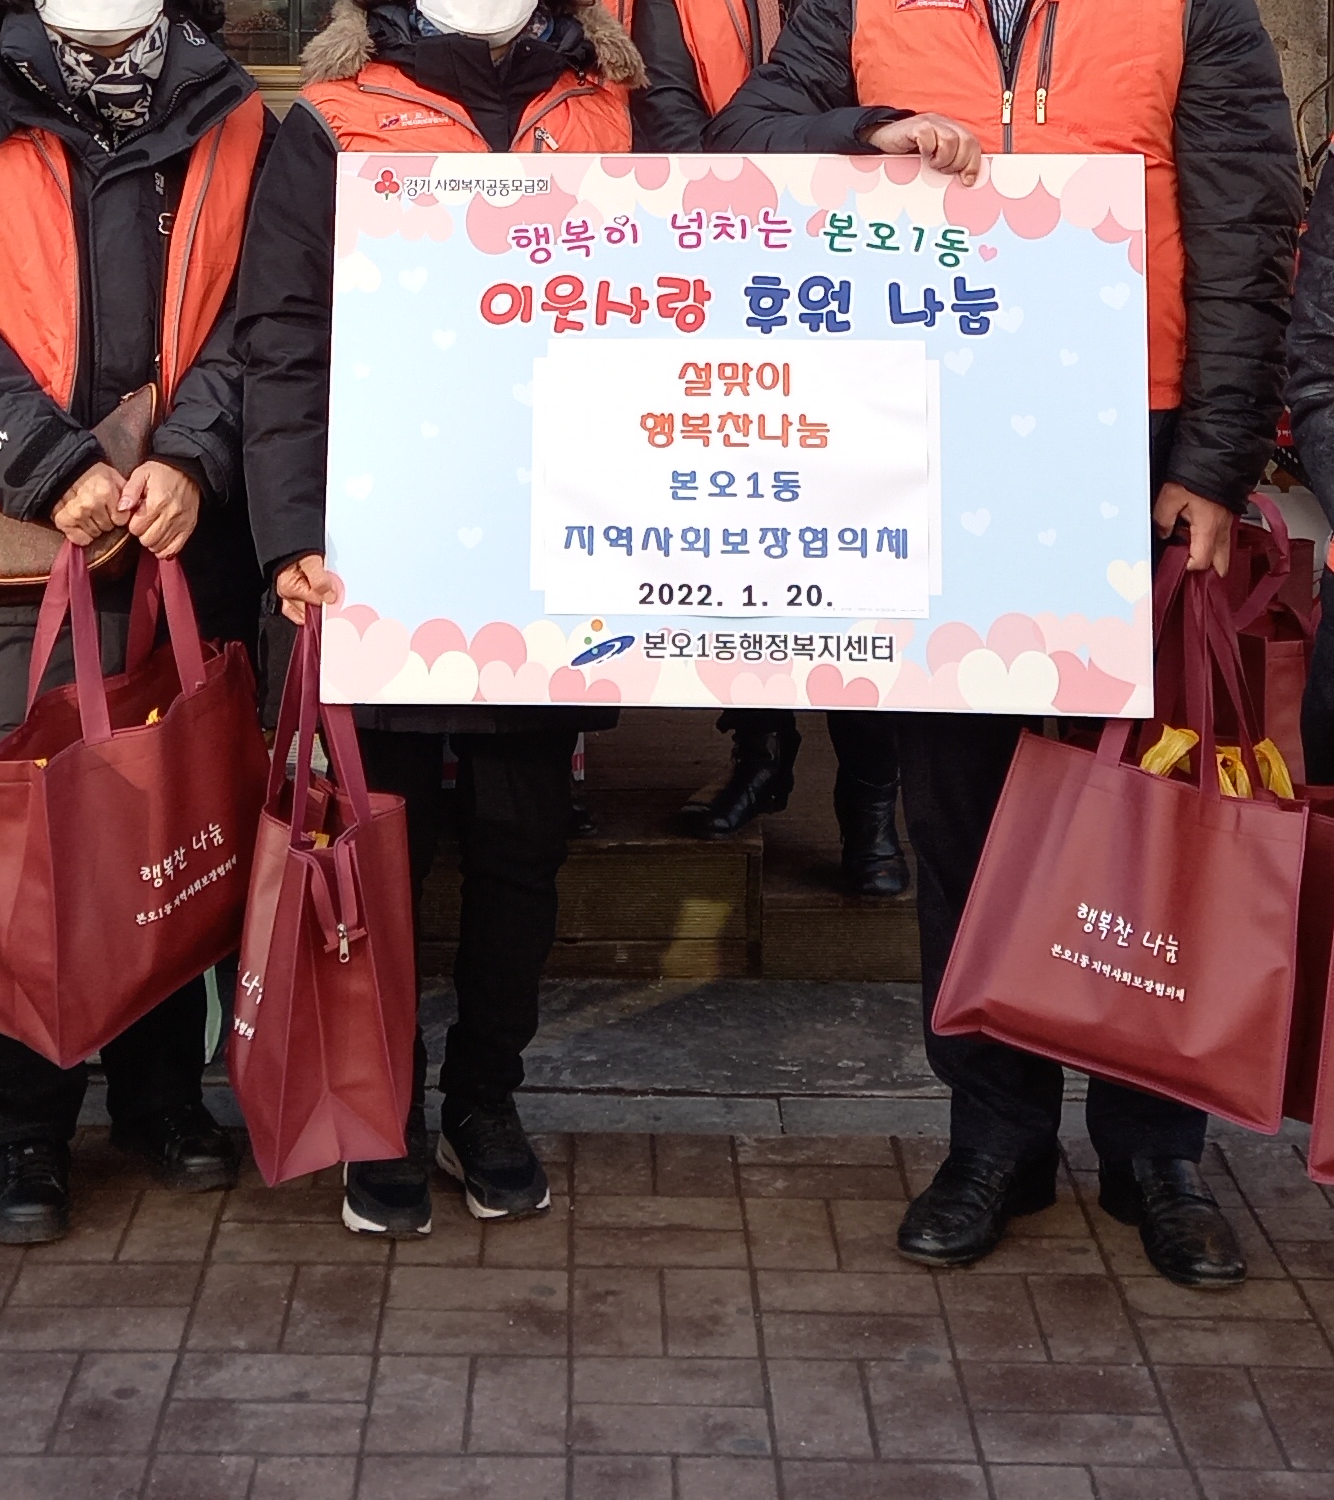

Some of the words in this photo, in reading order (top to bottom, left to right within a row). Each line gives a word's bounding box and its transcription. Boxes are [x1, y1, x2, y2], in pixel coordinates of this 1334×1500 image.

[404, 179, 431, 197] 경기
[434, 178, 549, 197] 사회복지공동모금회
[511, 217, 639, 264] 행복이
[671, 210, 792, 249] 넘치는
[823, 212, 970, 268] 본오1동
[480, 274, 712, 333] 이웃사랑
[744, 275, 852, 334] 후원
[888, 276, 999, 335] 나눔
[677, 362, 790, 397] 설맞이
[639, 411, 831, 449] 행복찬나눔
[669, 470, 802, 503] 본오1동
[563, 525, 909, 560] 지역사회보장협의체
[638, 582, 724, 607] 2022.
[742, 584, 769, 607] 1.
[786, 583, 834, 608] 20.
[643, 631, 895, 663] 본오1동행정복지센터
[140, 846, 187, 888] 행복찬
[192, 822, 224, 851] 나눔
[1077, 902, 1134, 947] 행복찬
[1142, 931, 1179, 964] 나눔
